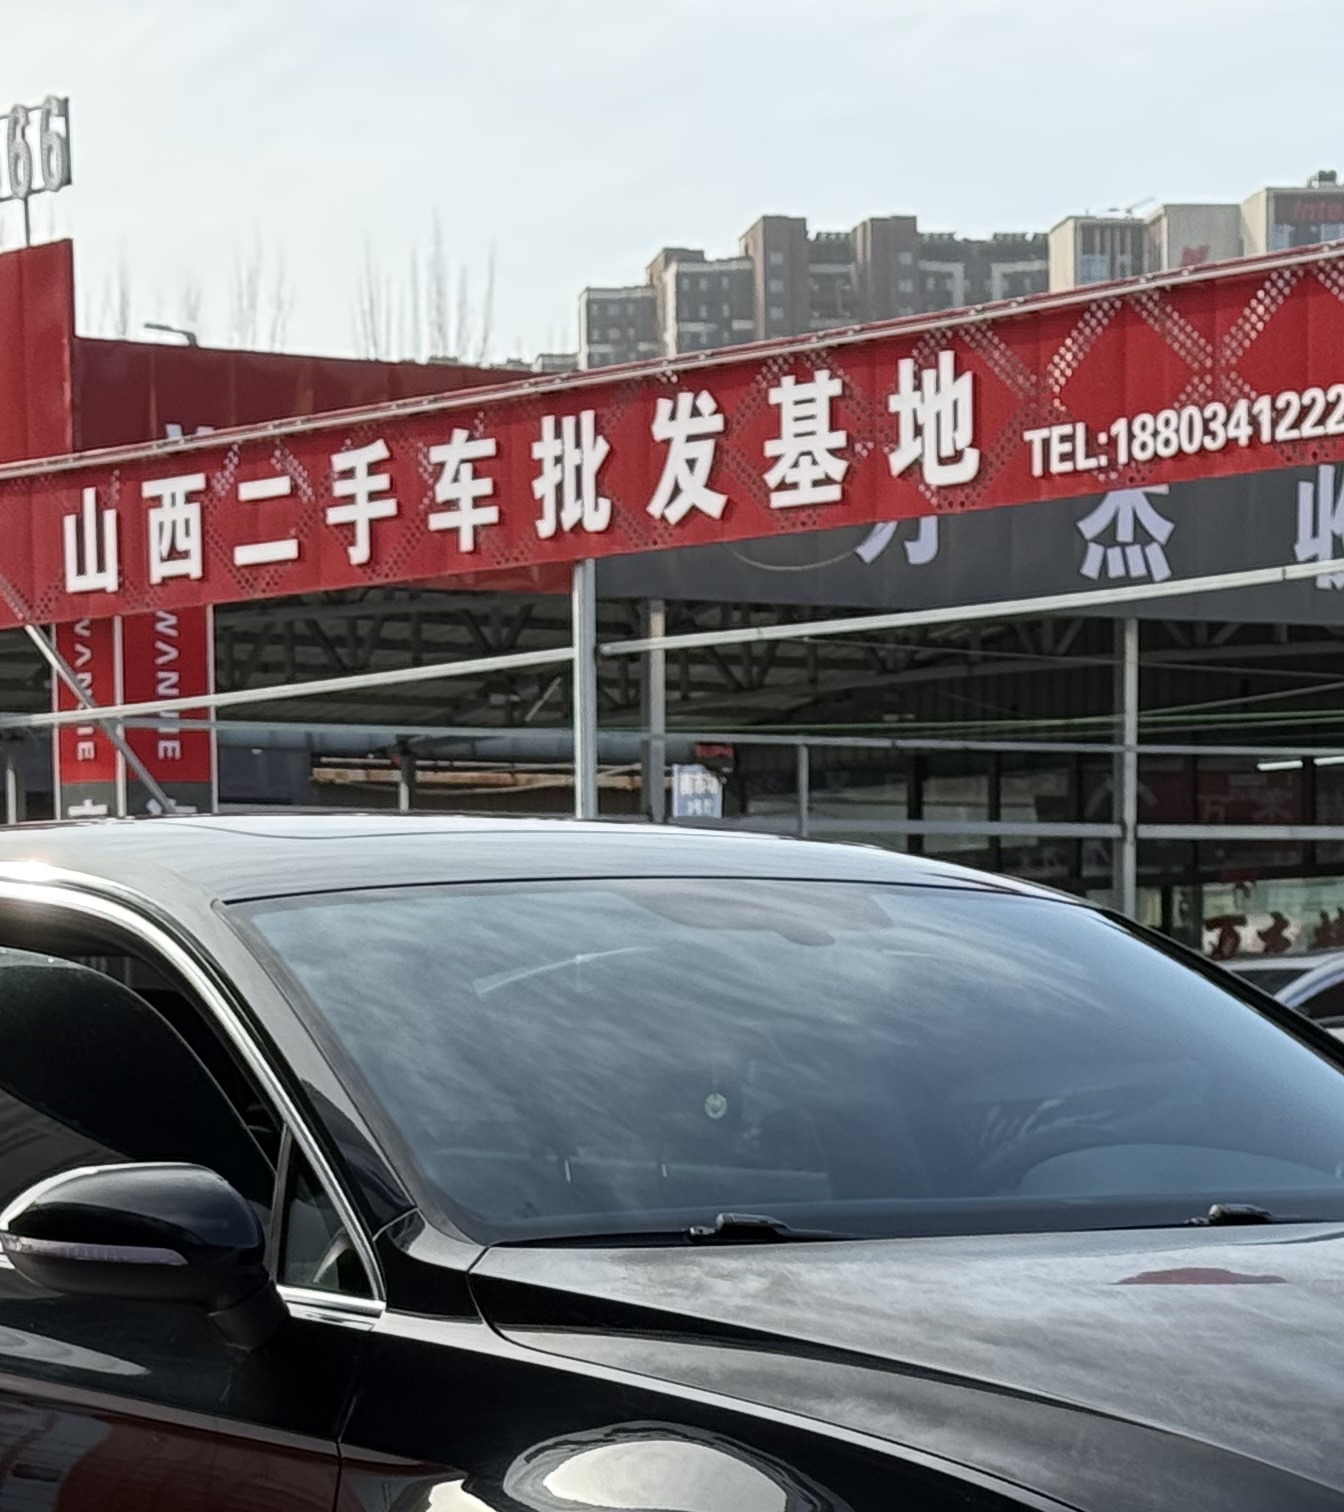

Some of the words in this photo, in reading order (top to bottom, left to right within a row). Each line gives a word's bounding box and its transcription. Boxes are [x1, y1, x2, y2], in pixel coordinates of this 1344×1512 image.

[62, 350, 980, 594] 山西二手车批发基地
